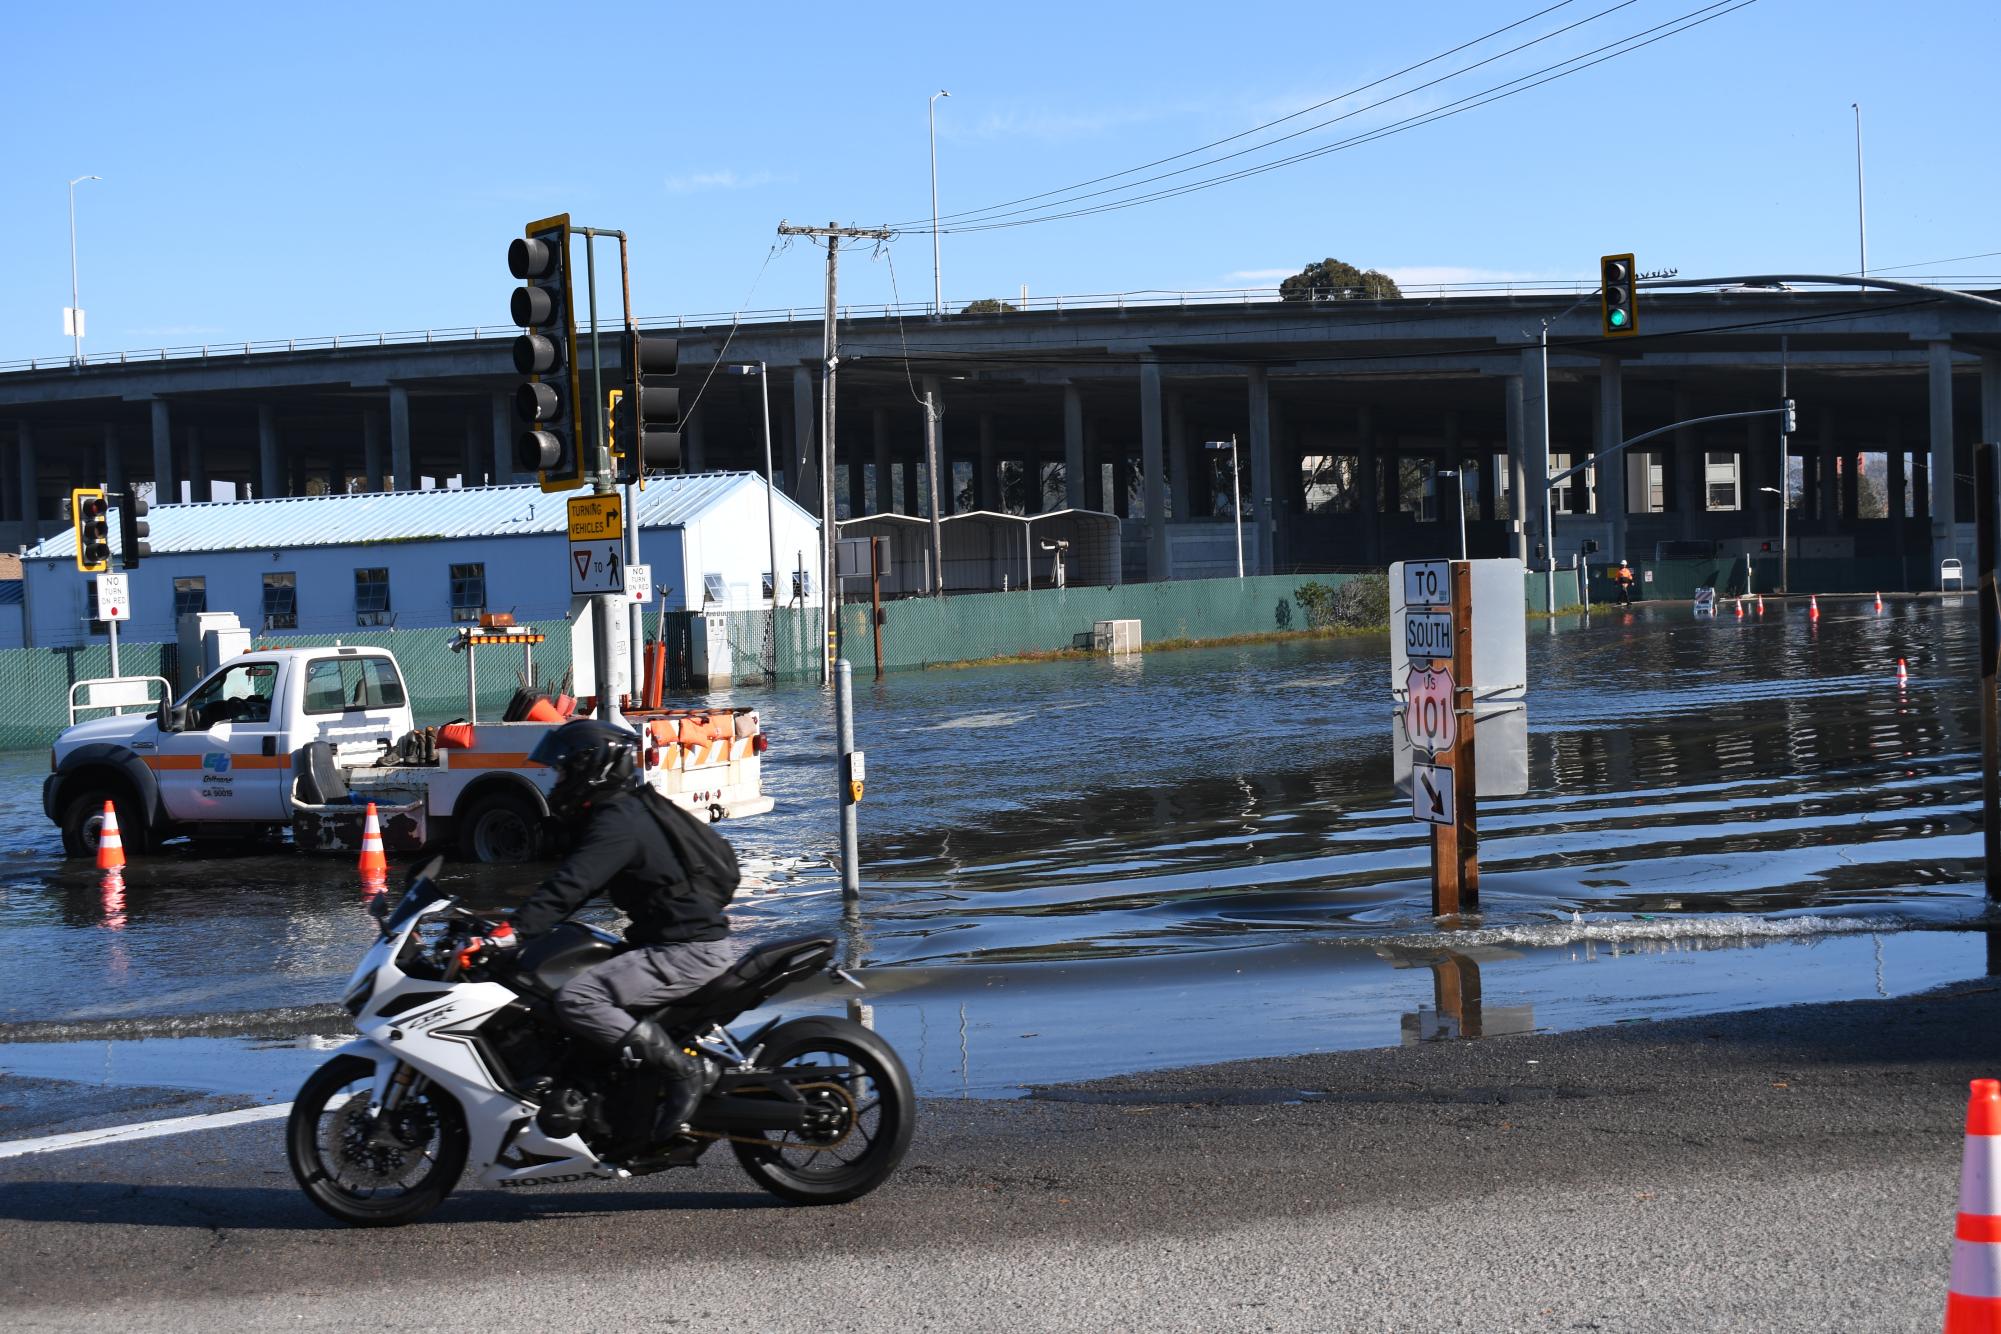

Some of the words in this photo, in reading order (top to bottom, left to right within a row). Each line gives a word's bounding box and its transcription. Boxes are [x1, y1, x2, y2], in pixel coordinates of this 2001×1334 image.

[572, 503, 602, 517] TURNING
[571, 522, 604, 534] VEHICLES
[594, 562, 603, 573] TO
[632, 567, 644, 575] NO
[106, 577, 119, 586] NO
[1415, 570, 1437, 597] TO
[105, 587, 122, 596] TURN
[101, 597, 111, 605] ON
[113, 596, 127, 604] RED
[1408, 619, 1450, 648] SOUTH
[1423, 676, 1436, 690] US
[1414, 695, 1447, 740] 101
[202, 789, 212, 797] CA
[498, 1171, 610, 1188] HONDA
